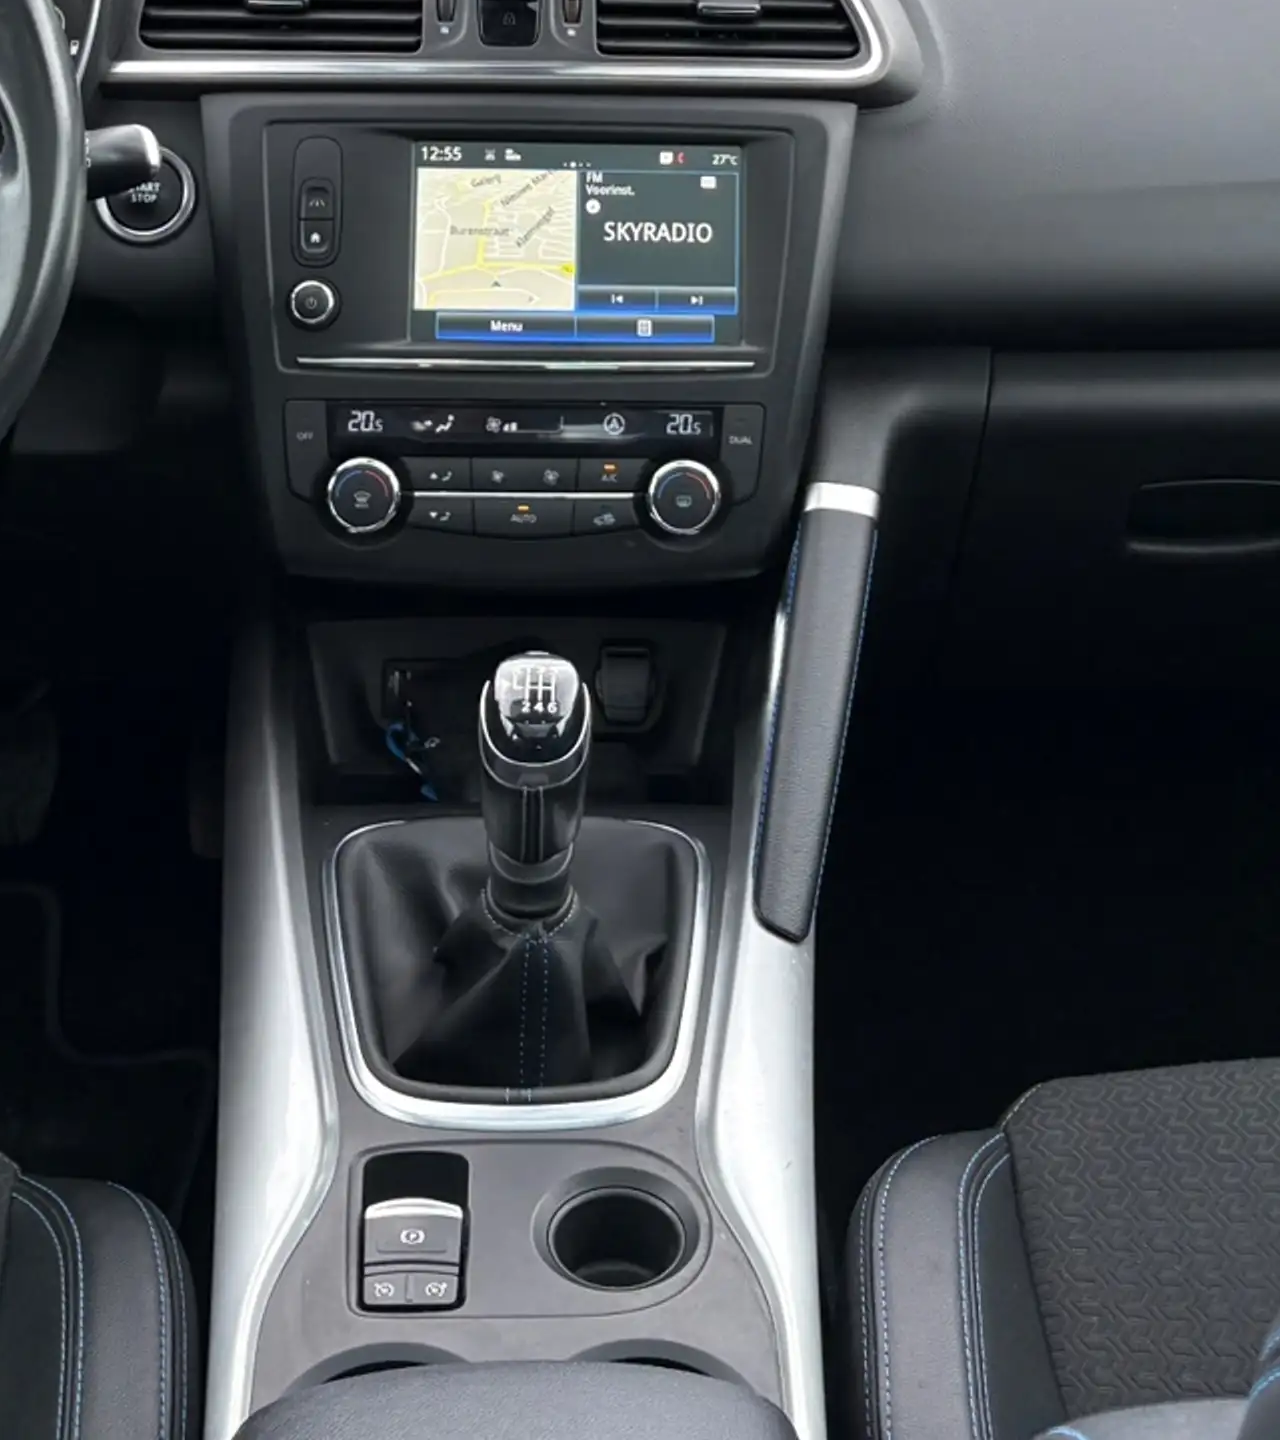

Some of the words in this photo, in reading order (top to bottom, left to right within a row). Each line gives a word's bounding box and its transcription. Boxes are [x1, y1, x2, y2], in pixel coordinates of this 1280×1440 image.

[421, 146, 462, 162] 12:55
[585, 171, 604, 184] FM
[130, 193, 158, 204] STOP
[603, 220, 714, 244] SKYRADIO
[490, 320, 524, 333] Menu
[296, 430, 314, 442] OFF
[728, 434, 754, 446] DUAL
[510, 513, 538, 524] AUTO
[522, 701, 531, 713] 2
[533, 702, 545, 714] 4
[547, 701, 557, 714] 6
